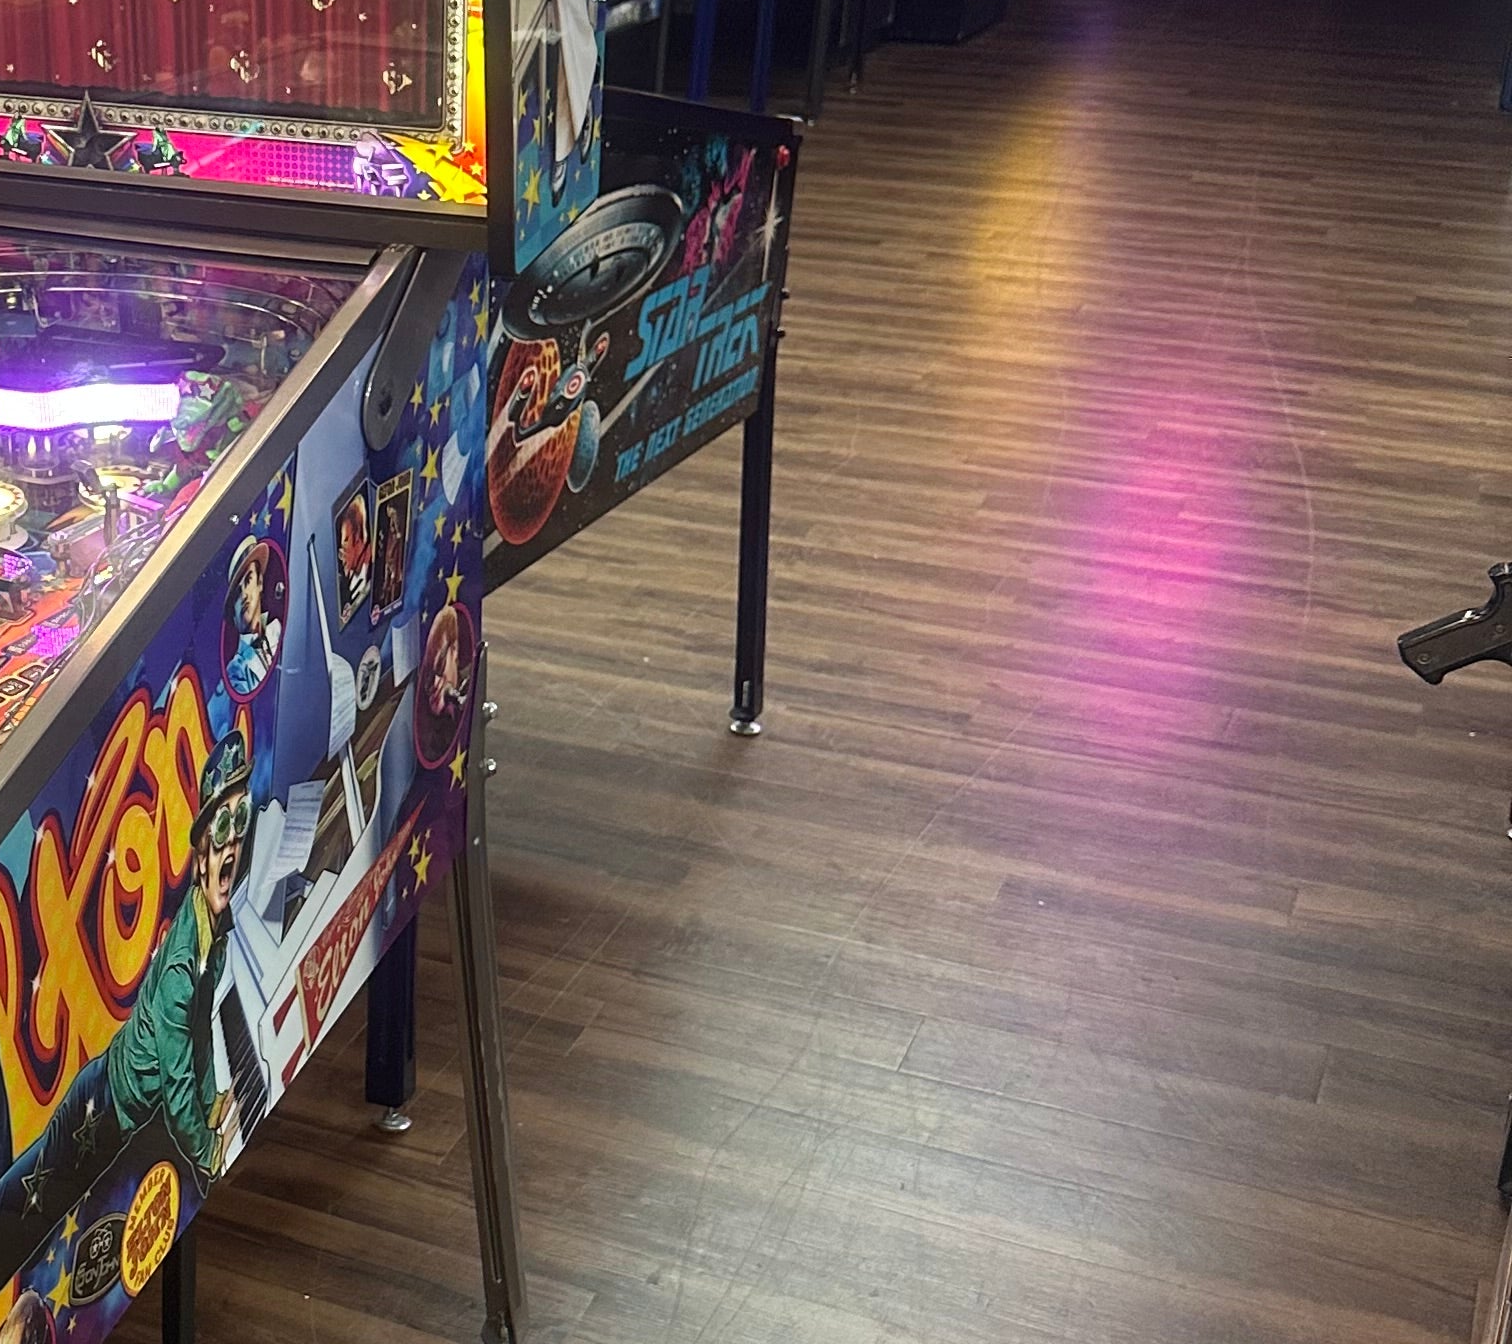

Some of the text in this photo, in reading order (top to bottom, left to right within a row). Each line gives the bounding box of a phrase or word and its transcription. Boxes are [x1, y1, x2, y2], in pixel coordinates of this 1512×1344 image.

[623, 264, 773, 391] STAR TREK
[615, 366, 759, 482] THE NEXT GENERATION
[316, 896, 370, 1022] Elton
[129, 1168, 166, 1230] MEMBER
[135, 1217, 175, 1287] FAN CLUB
